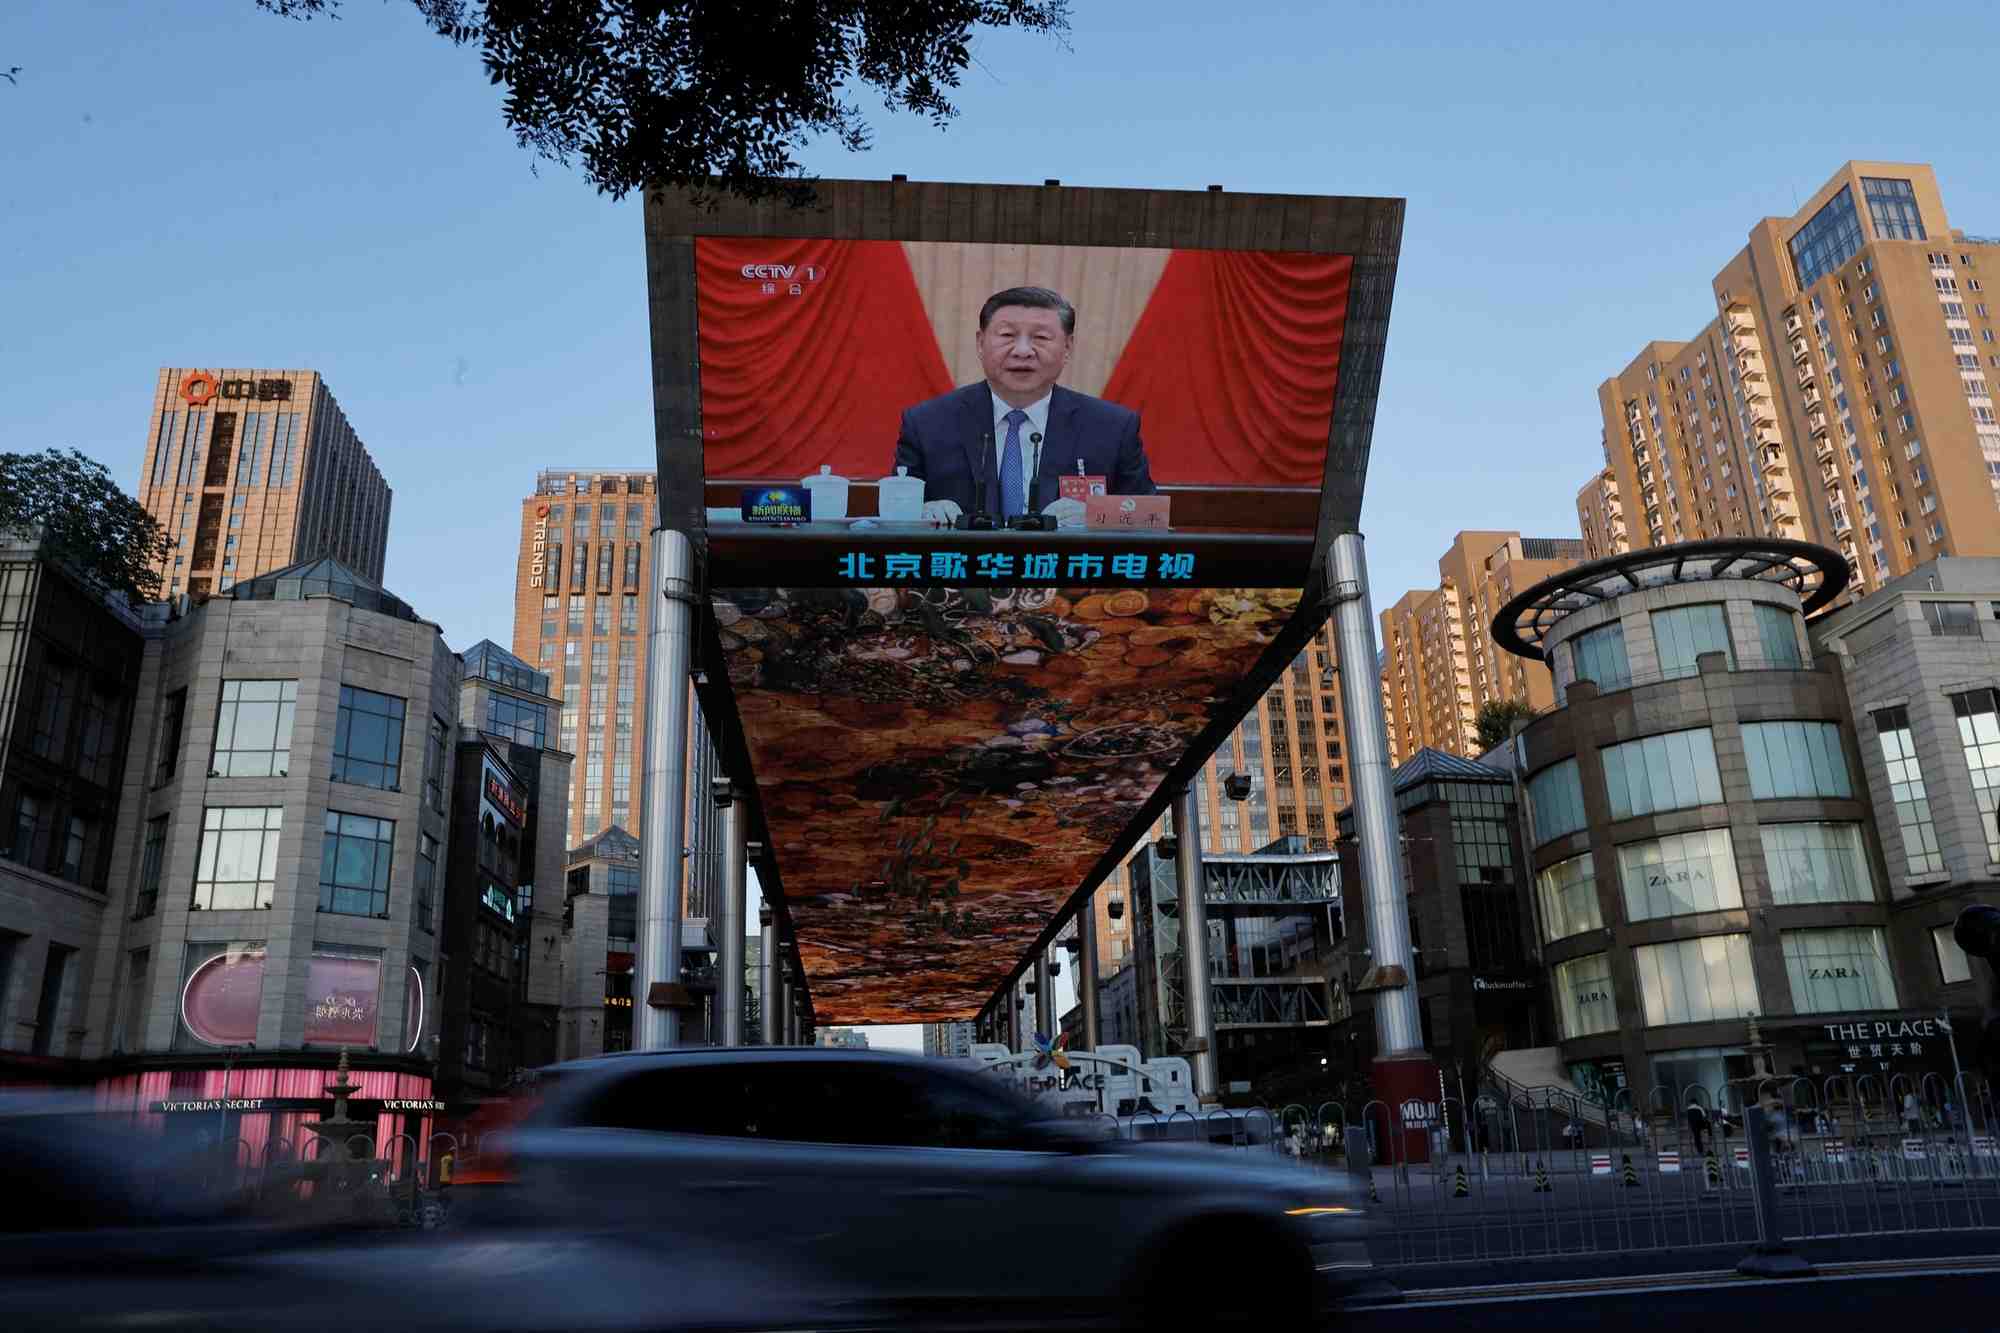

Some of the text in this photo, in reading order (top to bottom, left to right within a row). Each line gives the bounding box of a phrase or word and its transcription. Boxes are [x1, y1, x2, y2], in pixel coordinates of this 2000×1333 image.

[741, 264, 796, 279] CCTV
[530, 518, 547, 588] TRENDS
[838, 552, 1195, 580] 北京歌华城市电视
[1649, 869, 1705, 887] ZARA
[1808, 967, 1862, 979] ZARA
[1823, 1019, 1936, 1040] THE PLACE
[384, 1100, 433, 1110] VICTORIA'S
[1400, 1102, 1437, 1119] MUJI
